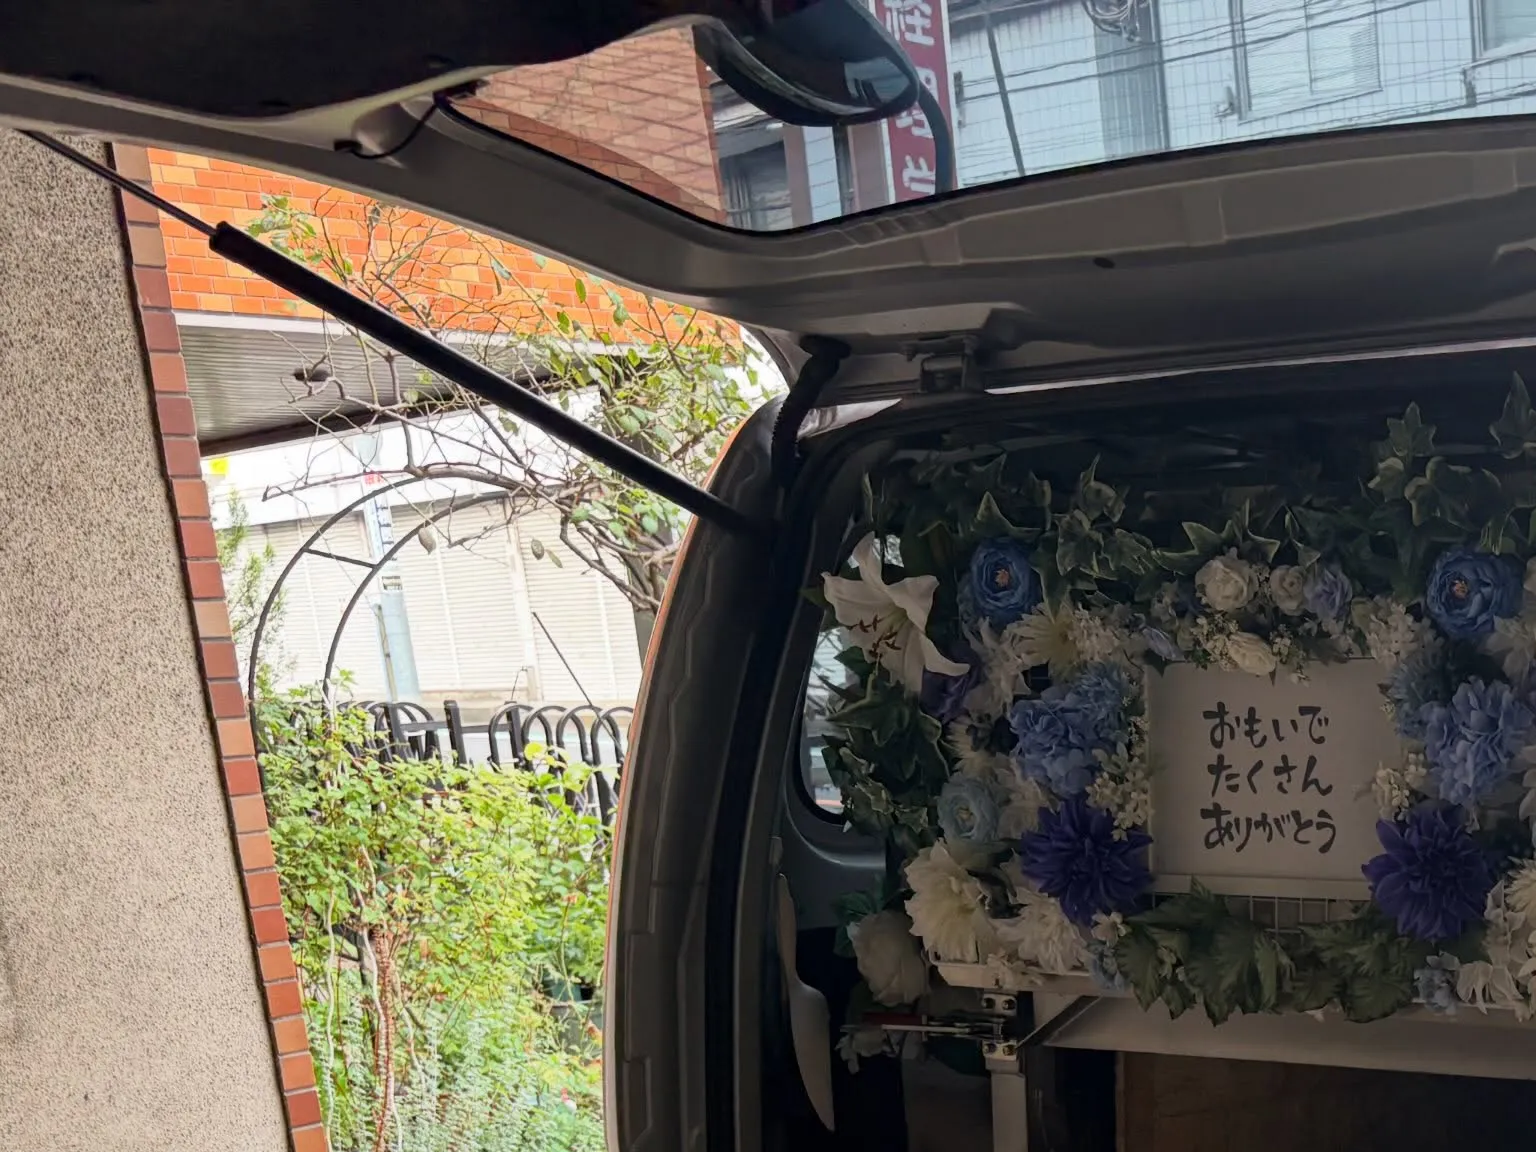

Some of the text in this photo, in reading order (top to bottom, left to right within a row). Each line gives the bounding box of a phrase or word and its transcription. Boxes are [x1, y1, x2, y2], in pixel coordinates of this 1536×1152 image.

[1203, 701, 1329, 749] おもいで
[1207, 753, 1333, 797] たくさん
[1200, 802, 1337, 853] ありがとう
